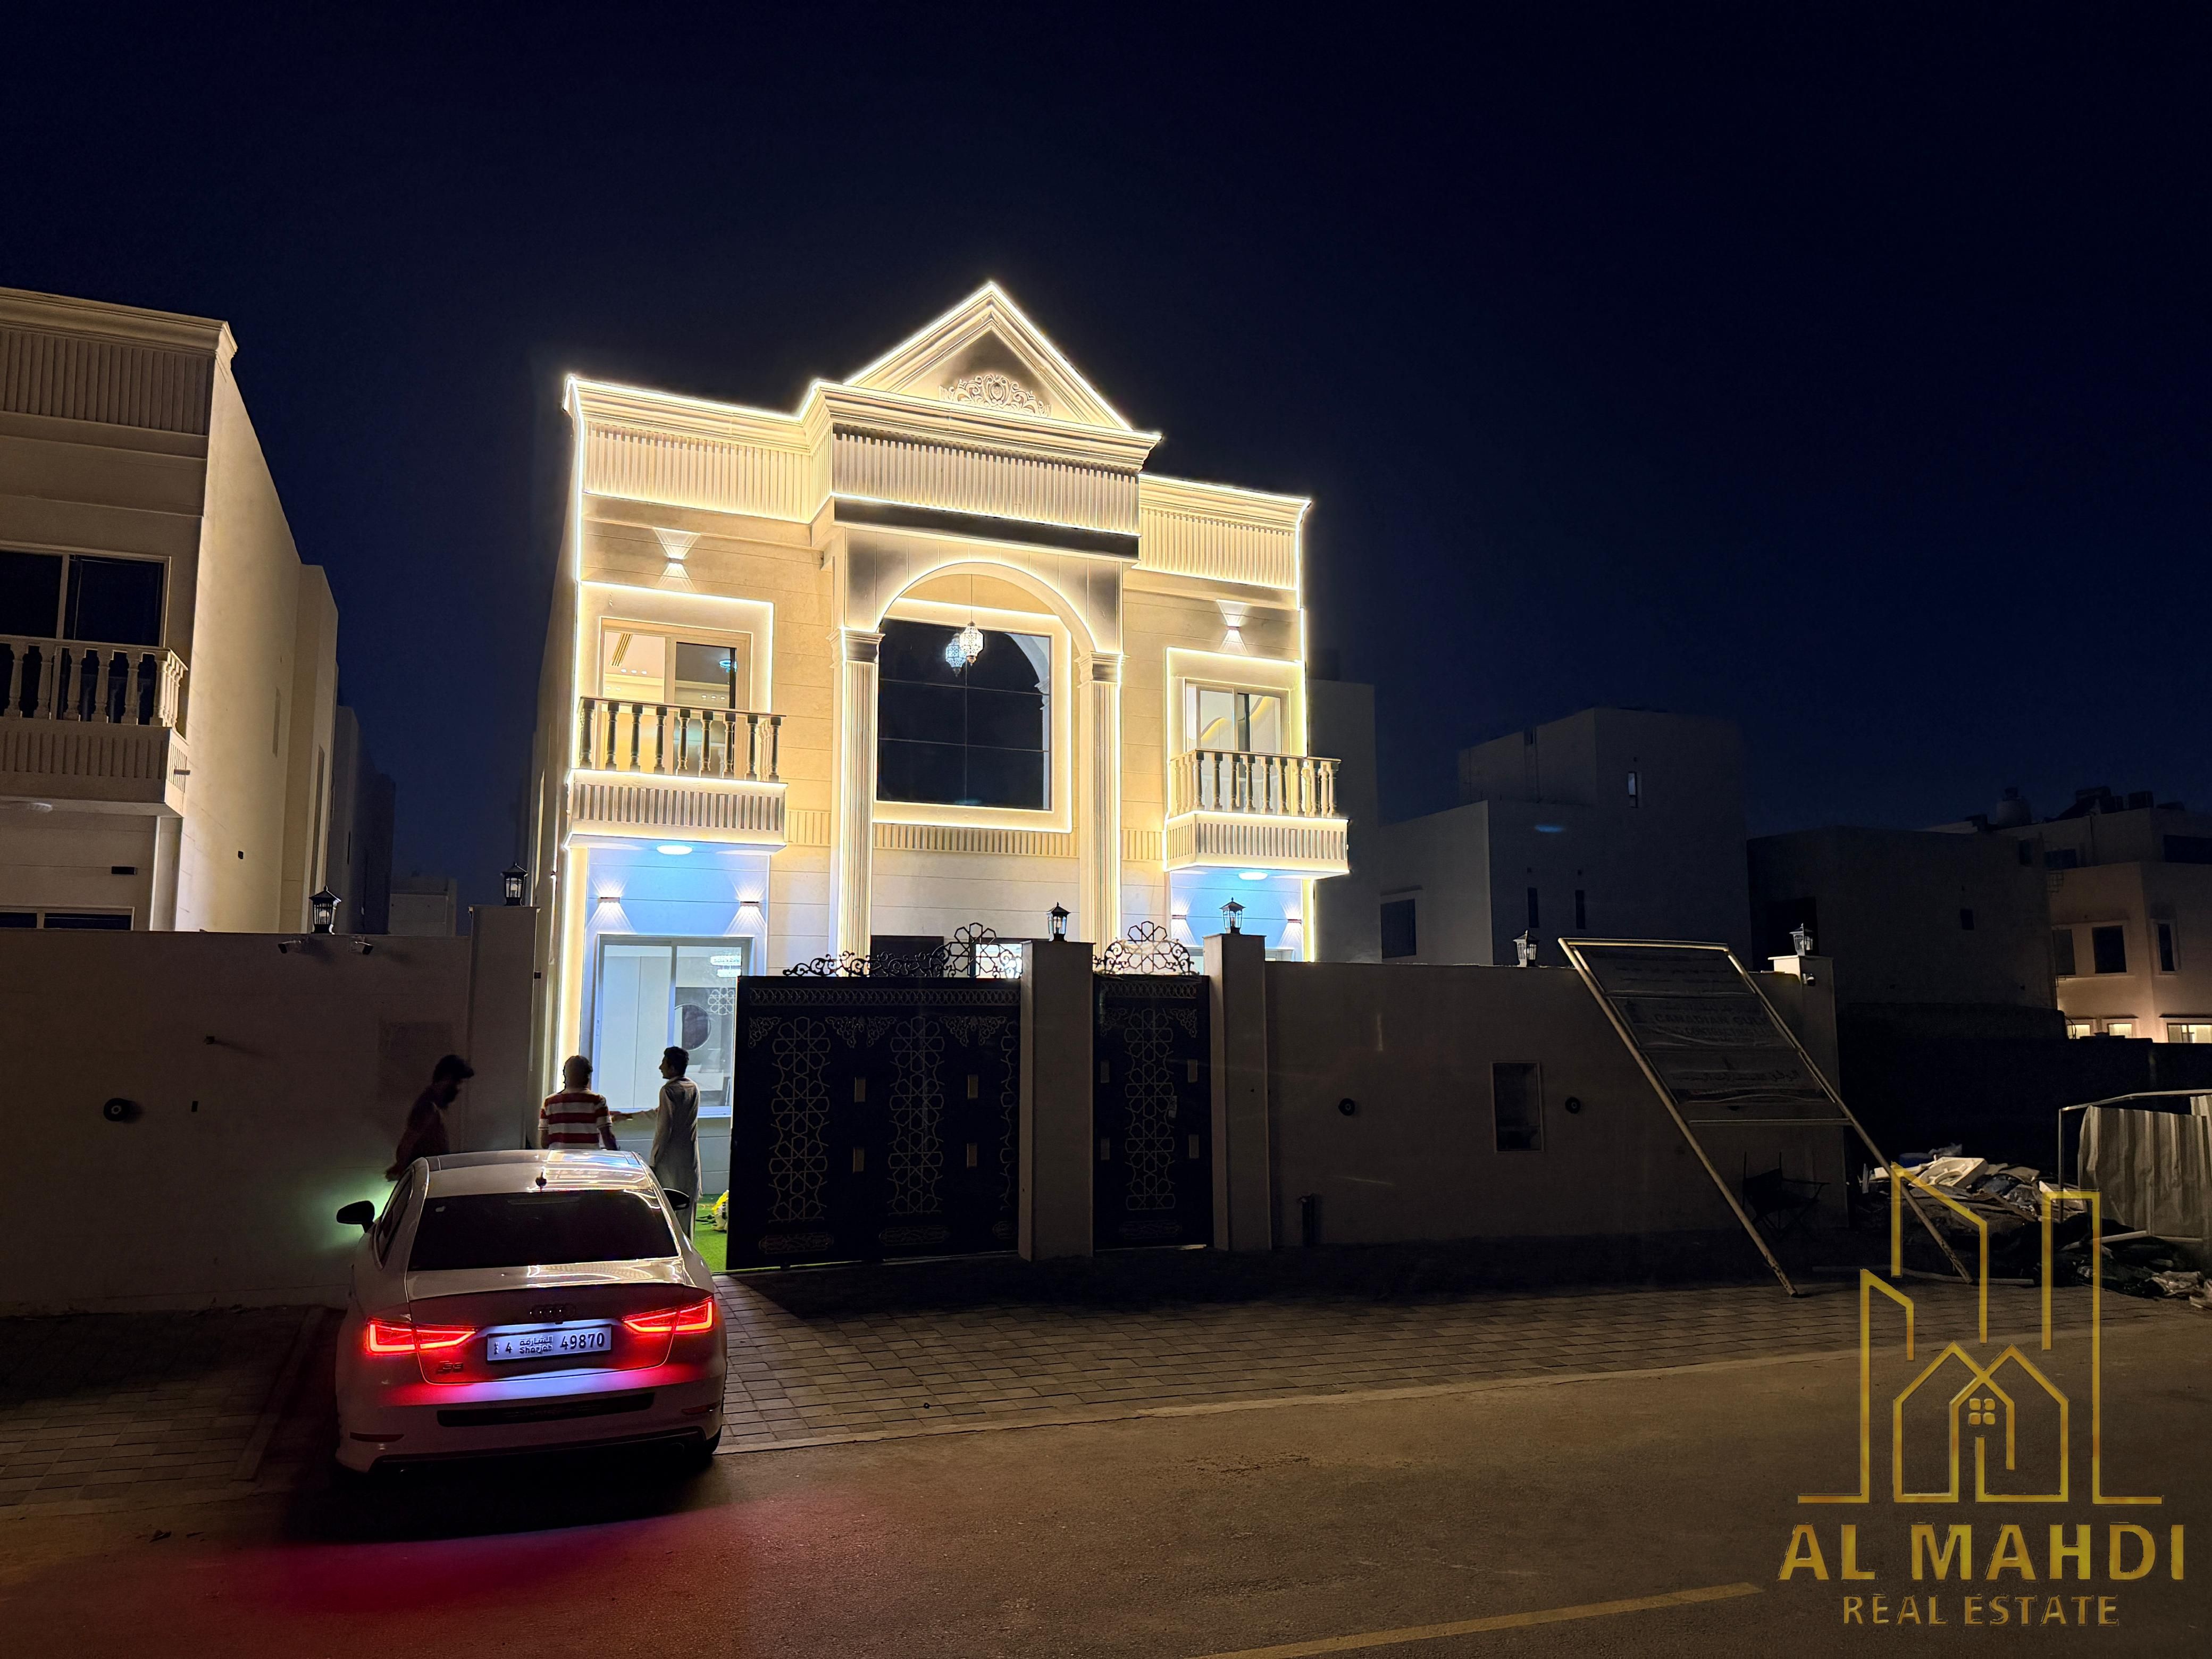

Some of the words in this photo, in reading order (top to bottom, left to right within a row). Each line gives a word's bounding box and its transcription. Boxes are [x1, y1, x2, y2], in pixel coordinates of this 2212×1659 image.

[506, 1342, 513, 1354] 4
[560, 1333, 605, 1350] 49870
[518, 1344, 553, 1355] Sharjah
